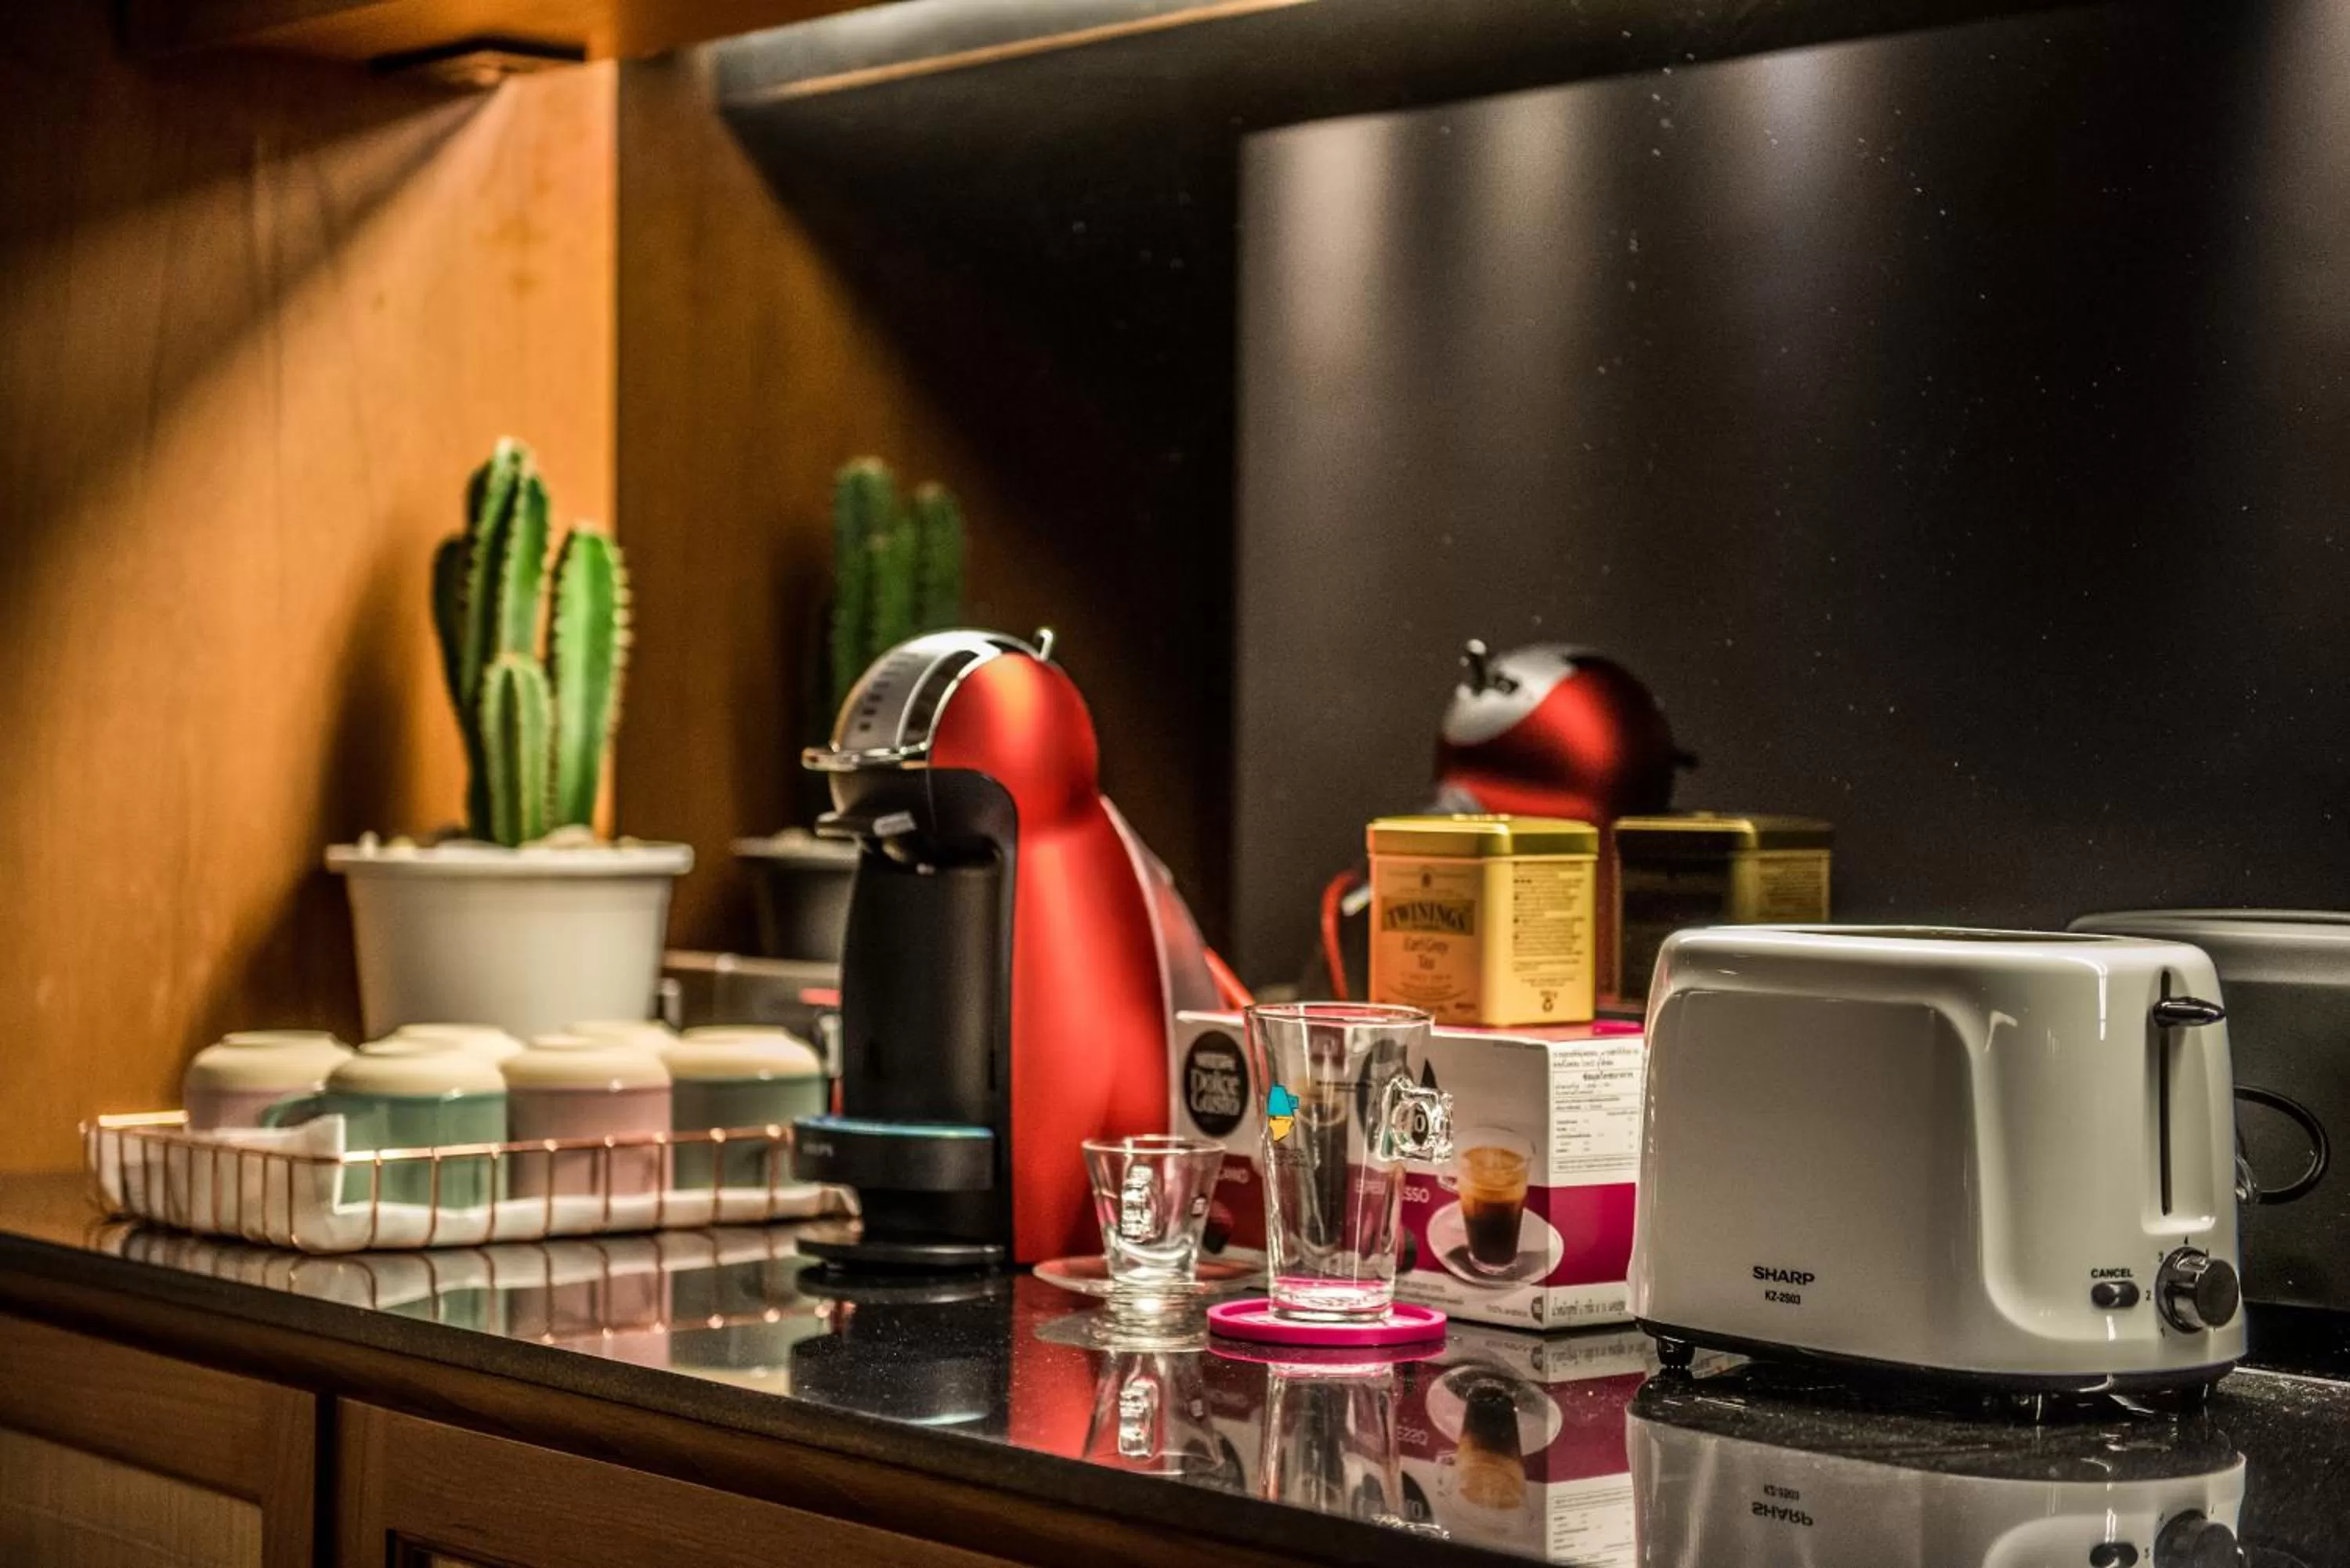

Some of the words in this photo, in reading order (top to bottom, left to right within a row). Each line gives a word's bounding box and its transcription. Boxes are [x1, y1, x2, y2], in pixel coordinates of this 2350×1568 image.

[1387, 901, 1465, 930] TWININGS
[1752, 1266, 1815, 1285] SHARP
[2091, 1268, 2133, 1279] CANCEL
